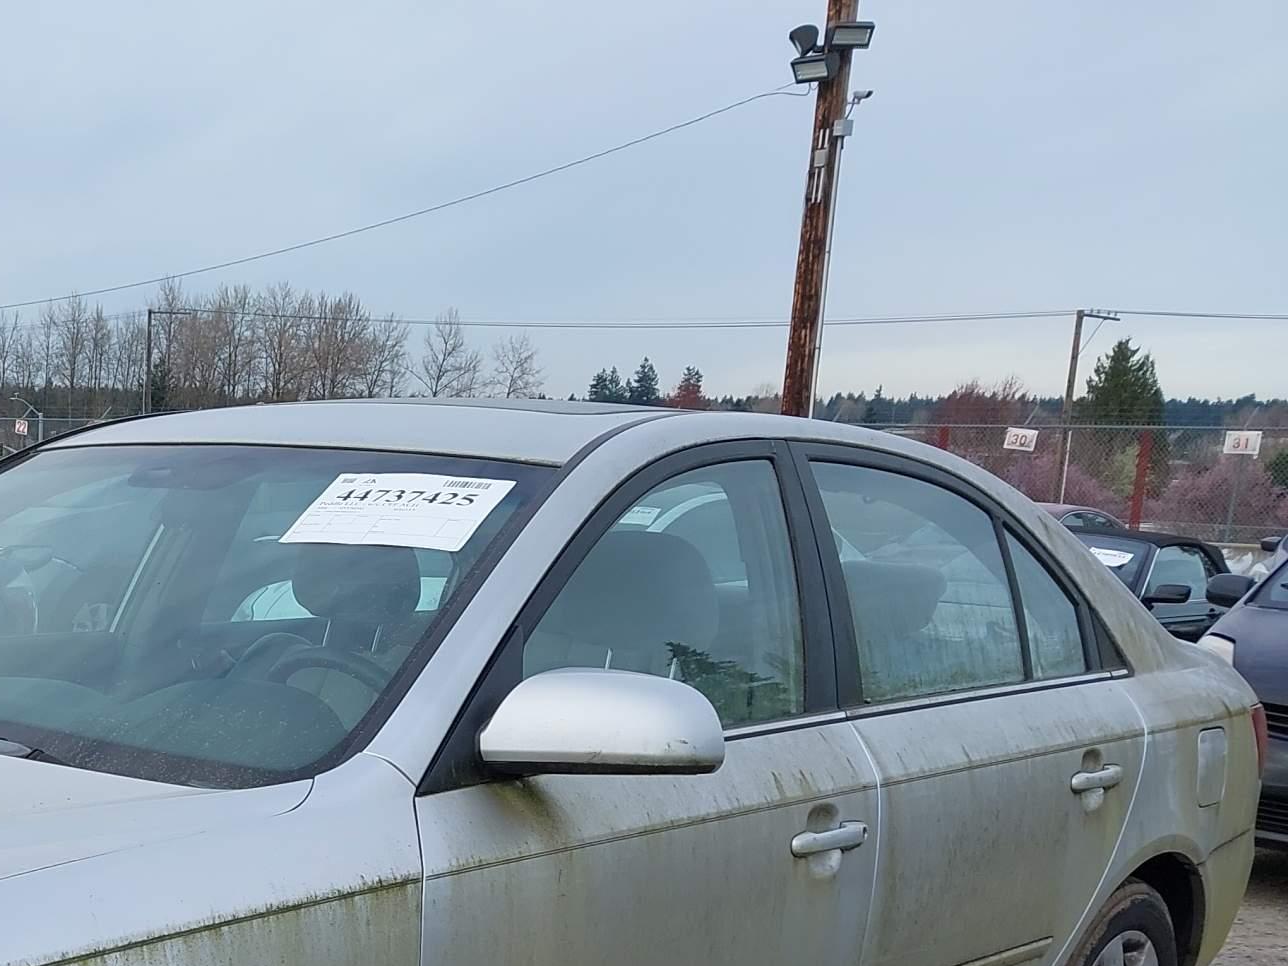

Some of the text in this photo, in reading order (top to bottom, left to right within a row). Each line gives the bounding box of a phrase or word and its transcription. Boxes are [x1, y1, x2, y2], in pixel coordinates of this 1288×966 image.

[16, 420, 27, 433] 22
[1012, 434, 1028, 446] 30
[1232, 438, 1249, 449] 31
[336, 488, 480, 506] 44737425
